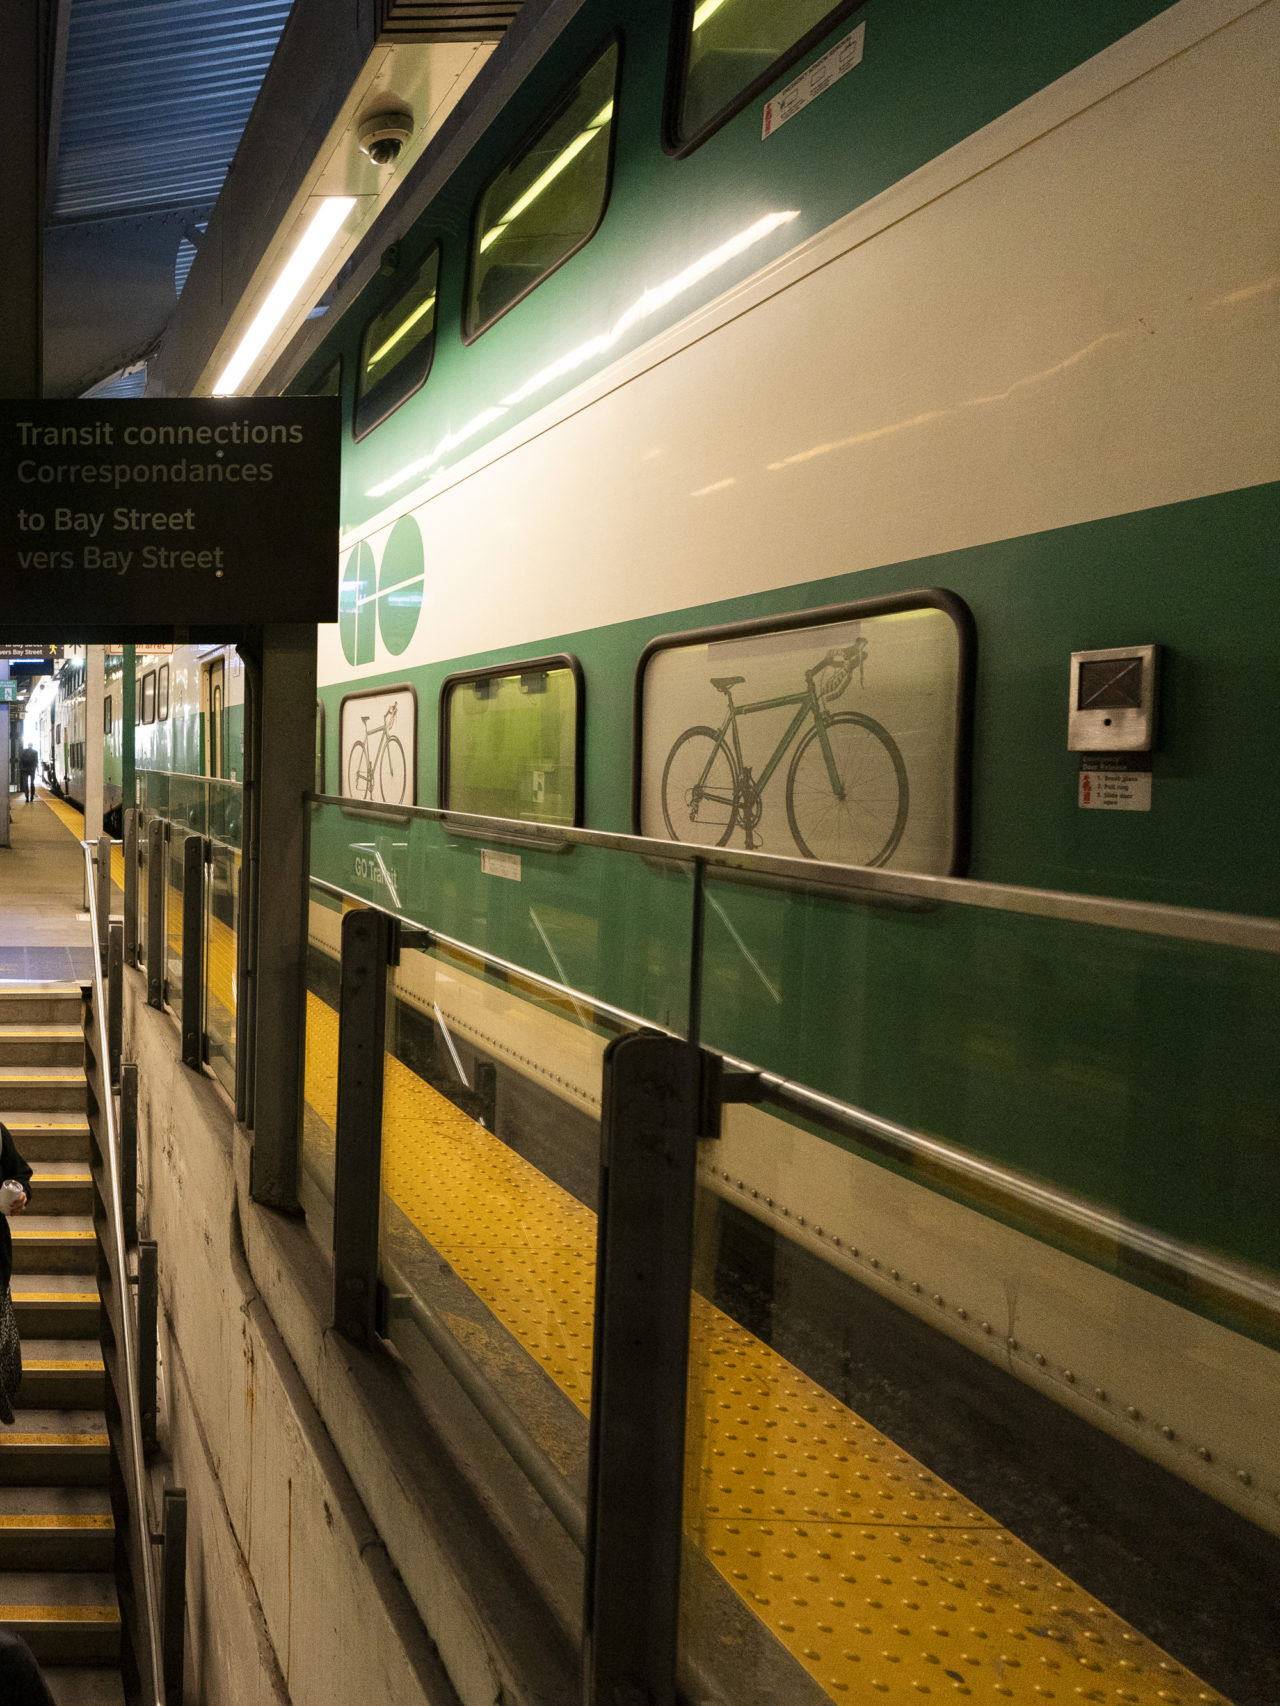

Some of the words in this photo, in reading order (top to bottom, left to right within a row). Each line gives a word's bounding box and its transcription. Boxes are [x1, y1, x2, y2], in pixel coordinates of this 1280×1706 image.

[16, 421, 112, 446] Transit
[124, 421, 304, 446] connections
[17, 458, 274, 488] Correspondances
[18, 509, 45, 532] to
[54, 508, 104, 537] Bay
[113, 508, 196, 532] Street
[18, 550, 74, 570] vers
[83, 546, 132, 575] Bay
[140, 546, 224, 570] Street
[355, 856, 368, 878] GO
